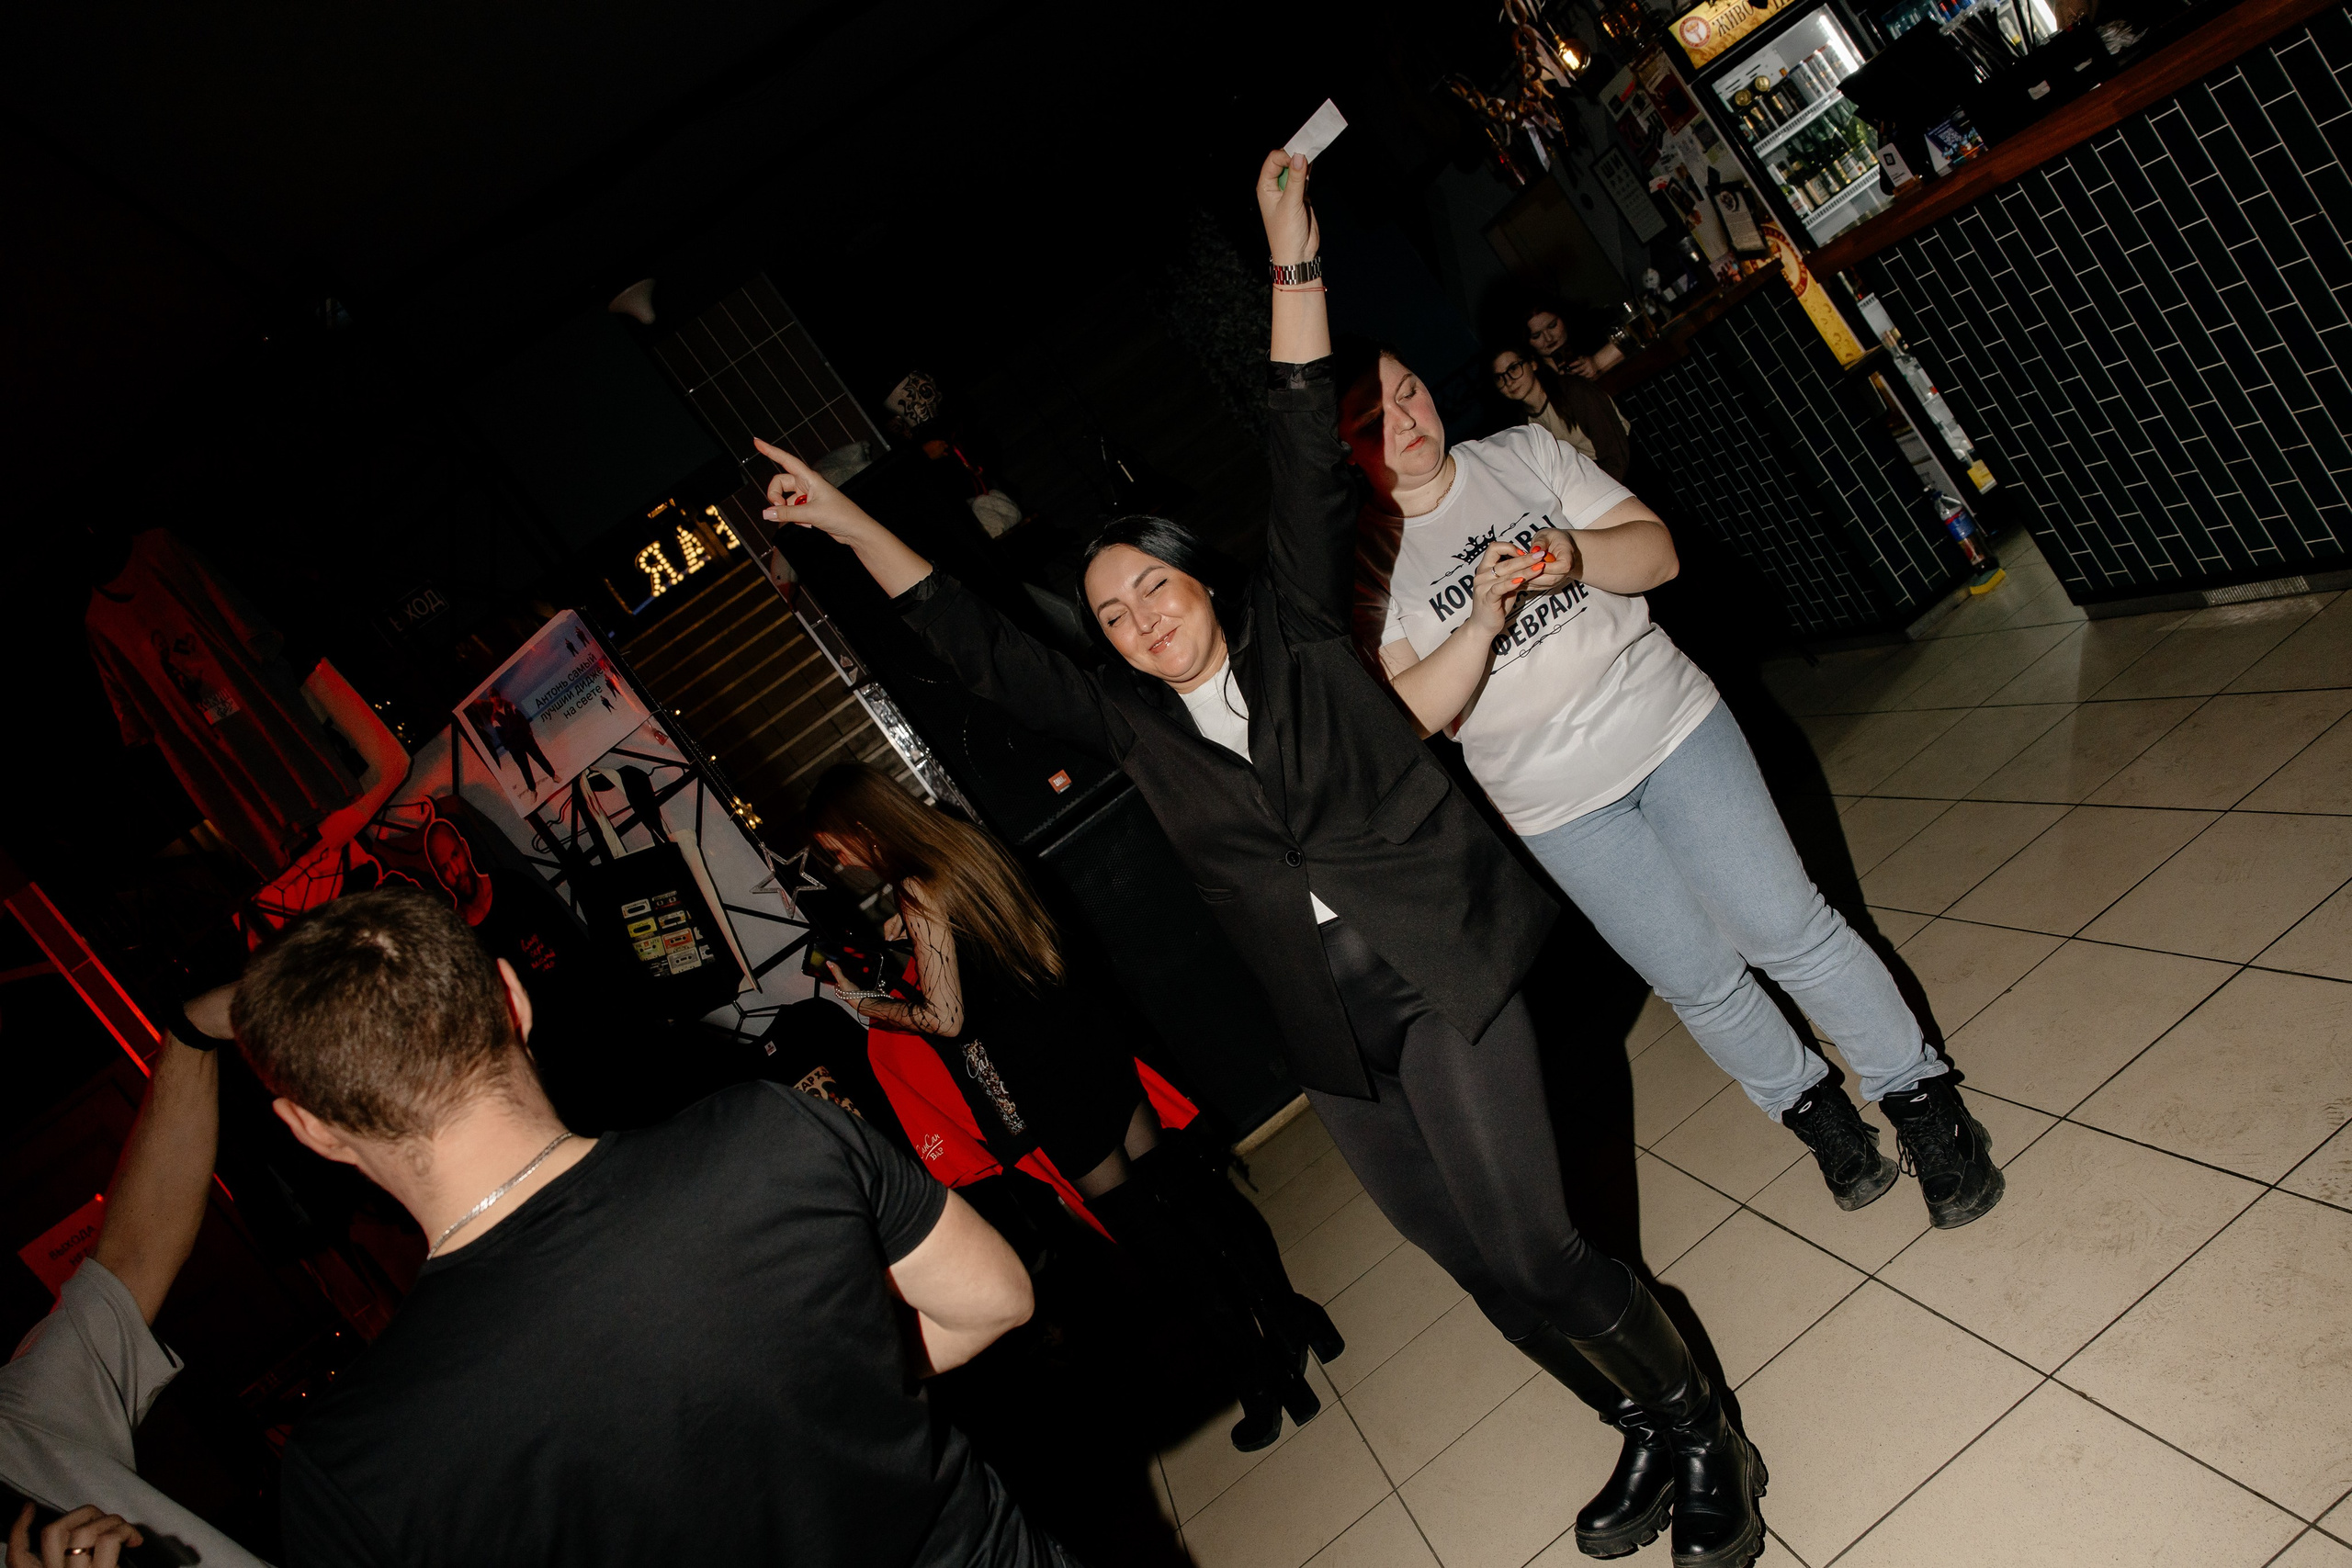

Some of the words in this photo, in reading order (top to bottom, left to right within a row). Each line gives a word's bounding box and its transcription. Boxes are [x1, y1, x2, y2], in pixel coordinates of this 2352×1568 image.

[1711, 0, 1755, 37] ЖИВО
[1429, 514, 1558, 623] КОРВЫ
[1491, 580, 1589, 657] ФЕВРАЛЕ
[536, 678, 569, 709] Антонь
[567, 653, 597, 682] самый
[563, 705, 577, 719] на
[576, 684, 603, 709] свете
[540, 690, 575, 722] лучший
